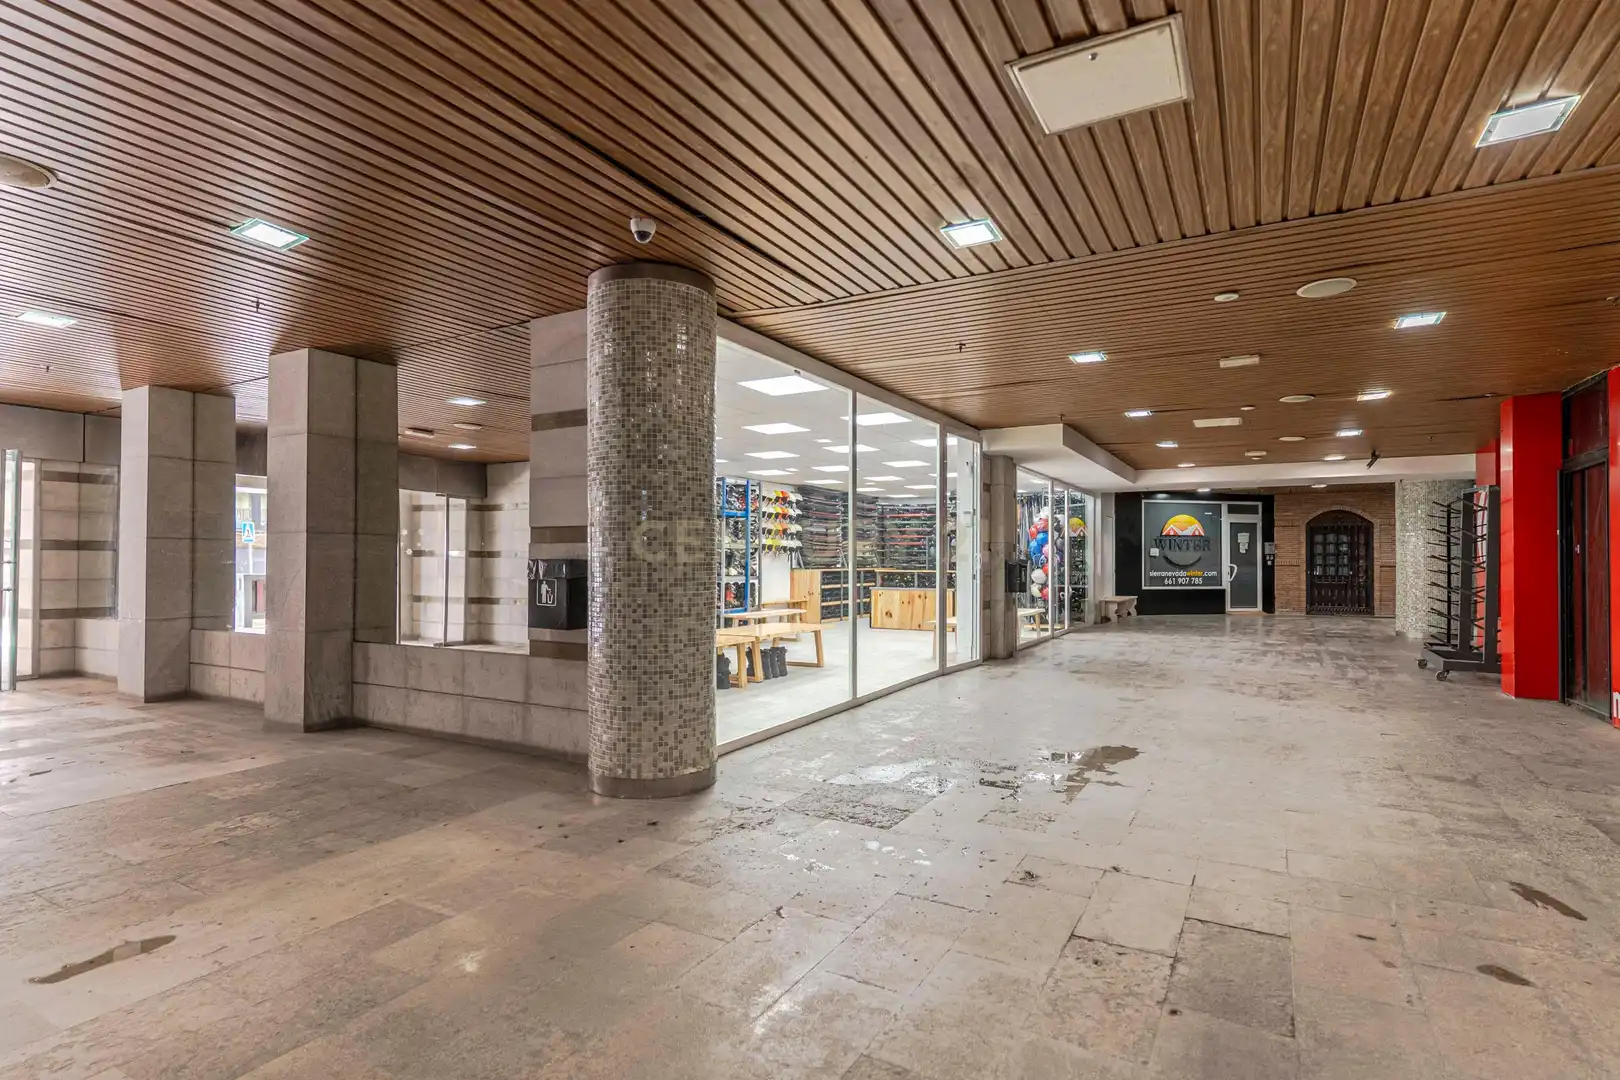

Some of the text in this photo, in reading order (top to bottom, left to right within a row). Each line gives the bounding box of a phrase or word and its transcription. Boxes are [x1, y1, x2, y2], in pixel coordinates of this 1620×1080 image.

[1153, 537, 1211, 551] WINTER
[1164, 577, 1203, 585] 661 907 785
